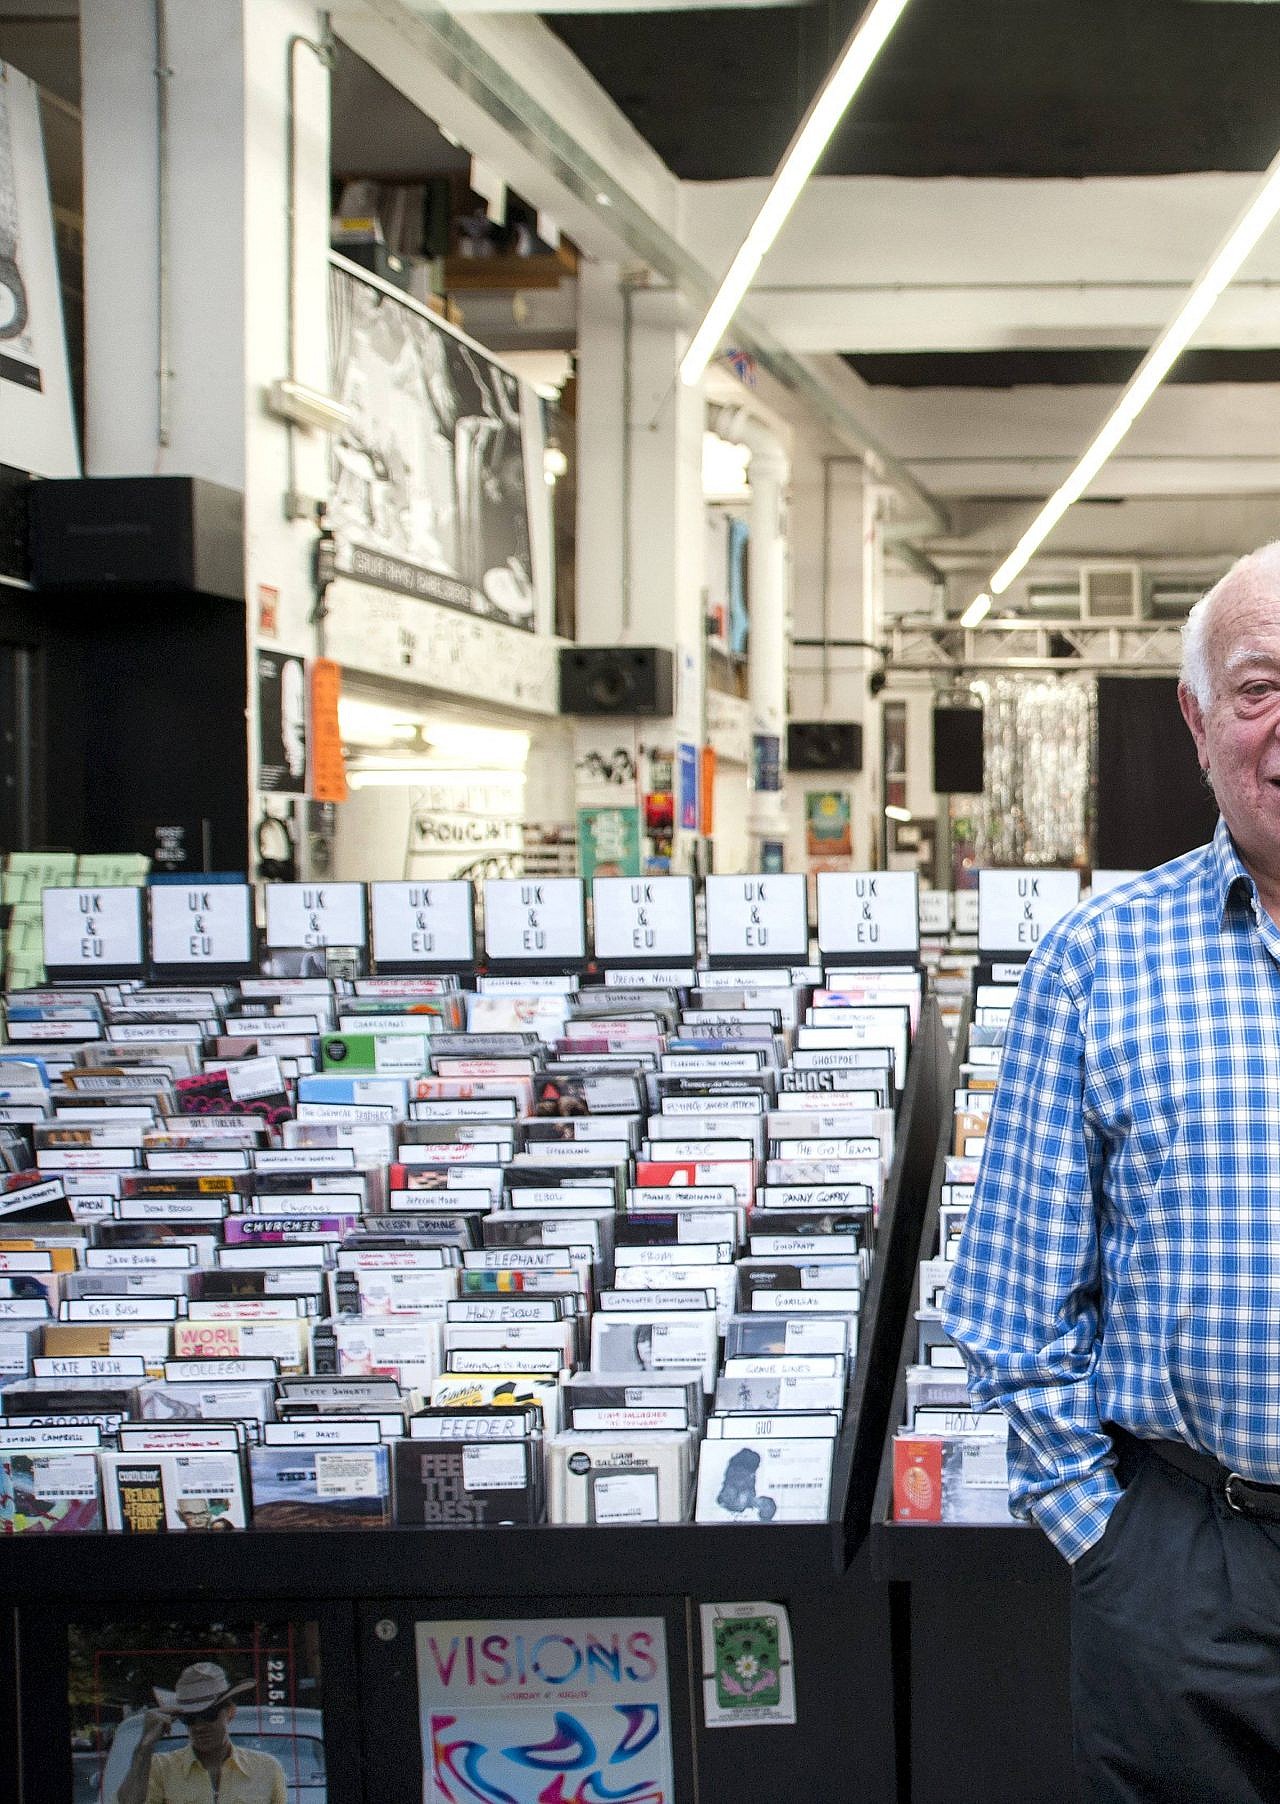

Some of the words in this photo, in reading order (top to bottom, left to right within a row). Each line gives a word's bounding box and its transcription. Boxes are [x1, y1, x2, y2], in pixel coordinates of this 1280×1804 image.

[521, 886, 543, 904] UK
[631, 884, 653, 902] UK
[744, 883, 766, 901] UK
[856, 879, 877, 898] UK
[1017, 878, 1040, 897] UK
[80, 895, 102, 913] UK
[188, 893, 210, 912] UK
[303, 890, 325, 909] UK
[408, 889, 432, 908] UK
[523, 931, 545, 949] EU
[633, 930, 655, 948] EU
[746, 928, 767, 946] EU
[857, 924, 878, 943] EU
[1018, 924, 1040, 943] EU
[81, 939, 103, 958] EU
[190, 937, 213, 956] EU
[411, 934, 434, 952] EU
[812, 1055, 858, 1065] GHOSTPOET
[845, 1142, 871, 1154] TEAM
[783, 1192, 812, 1203] DANNY
[485, 1253, 553, 1266] ELEPHANT
[466, 1305, 497, 1319] HOLY
[52, 1362, 79, 1374] KATE
[92, 1361, 121, 1373] BUSH
[180, 1362, 245, 1376] COLLEEN
[440, 1420, 513, 1436] FEEDER
[945, 1414, 980, 1431] HOLY
[595, 1459, 648, 1467] GALLAGHER
[427, 1632, 657, 1688] VISIONS
